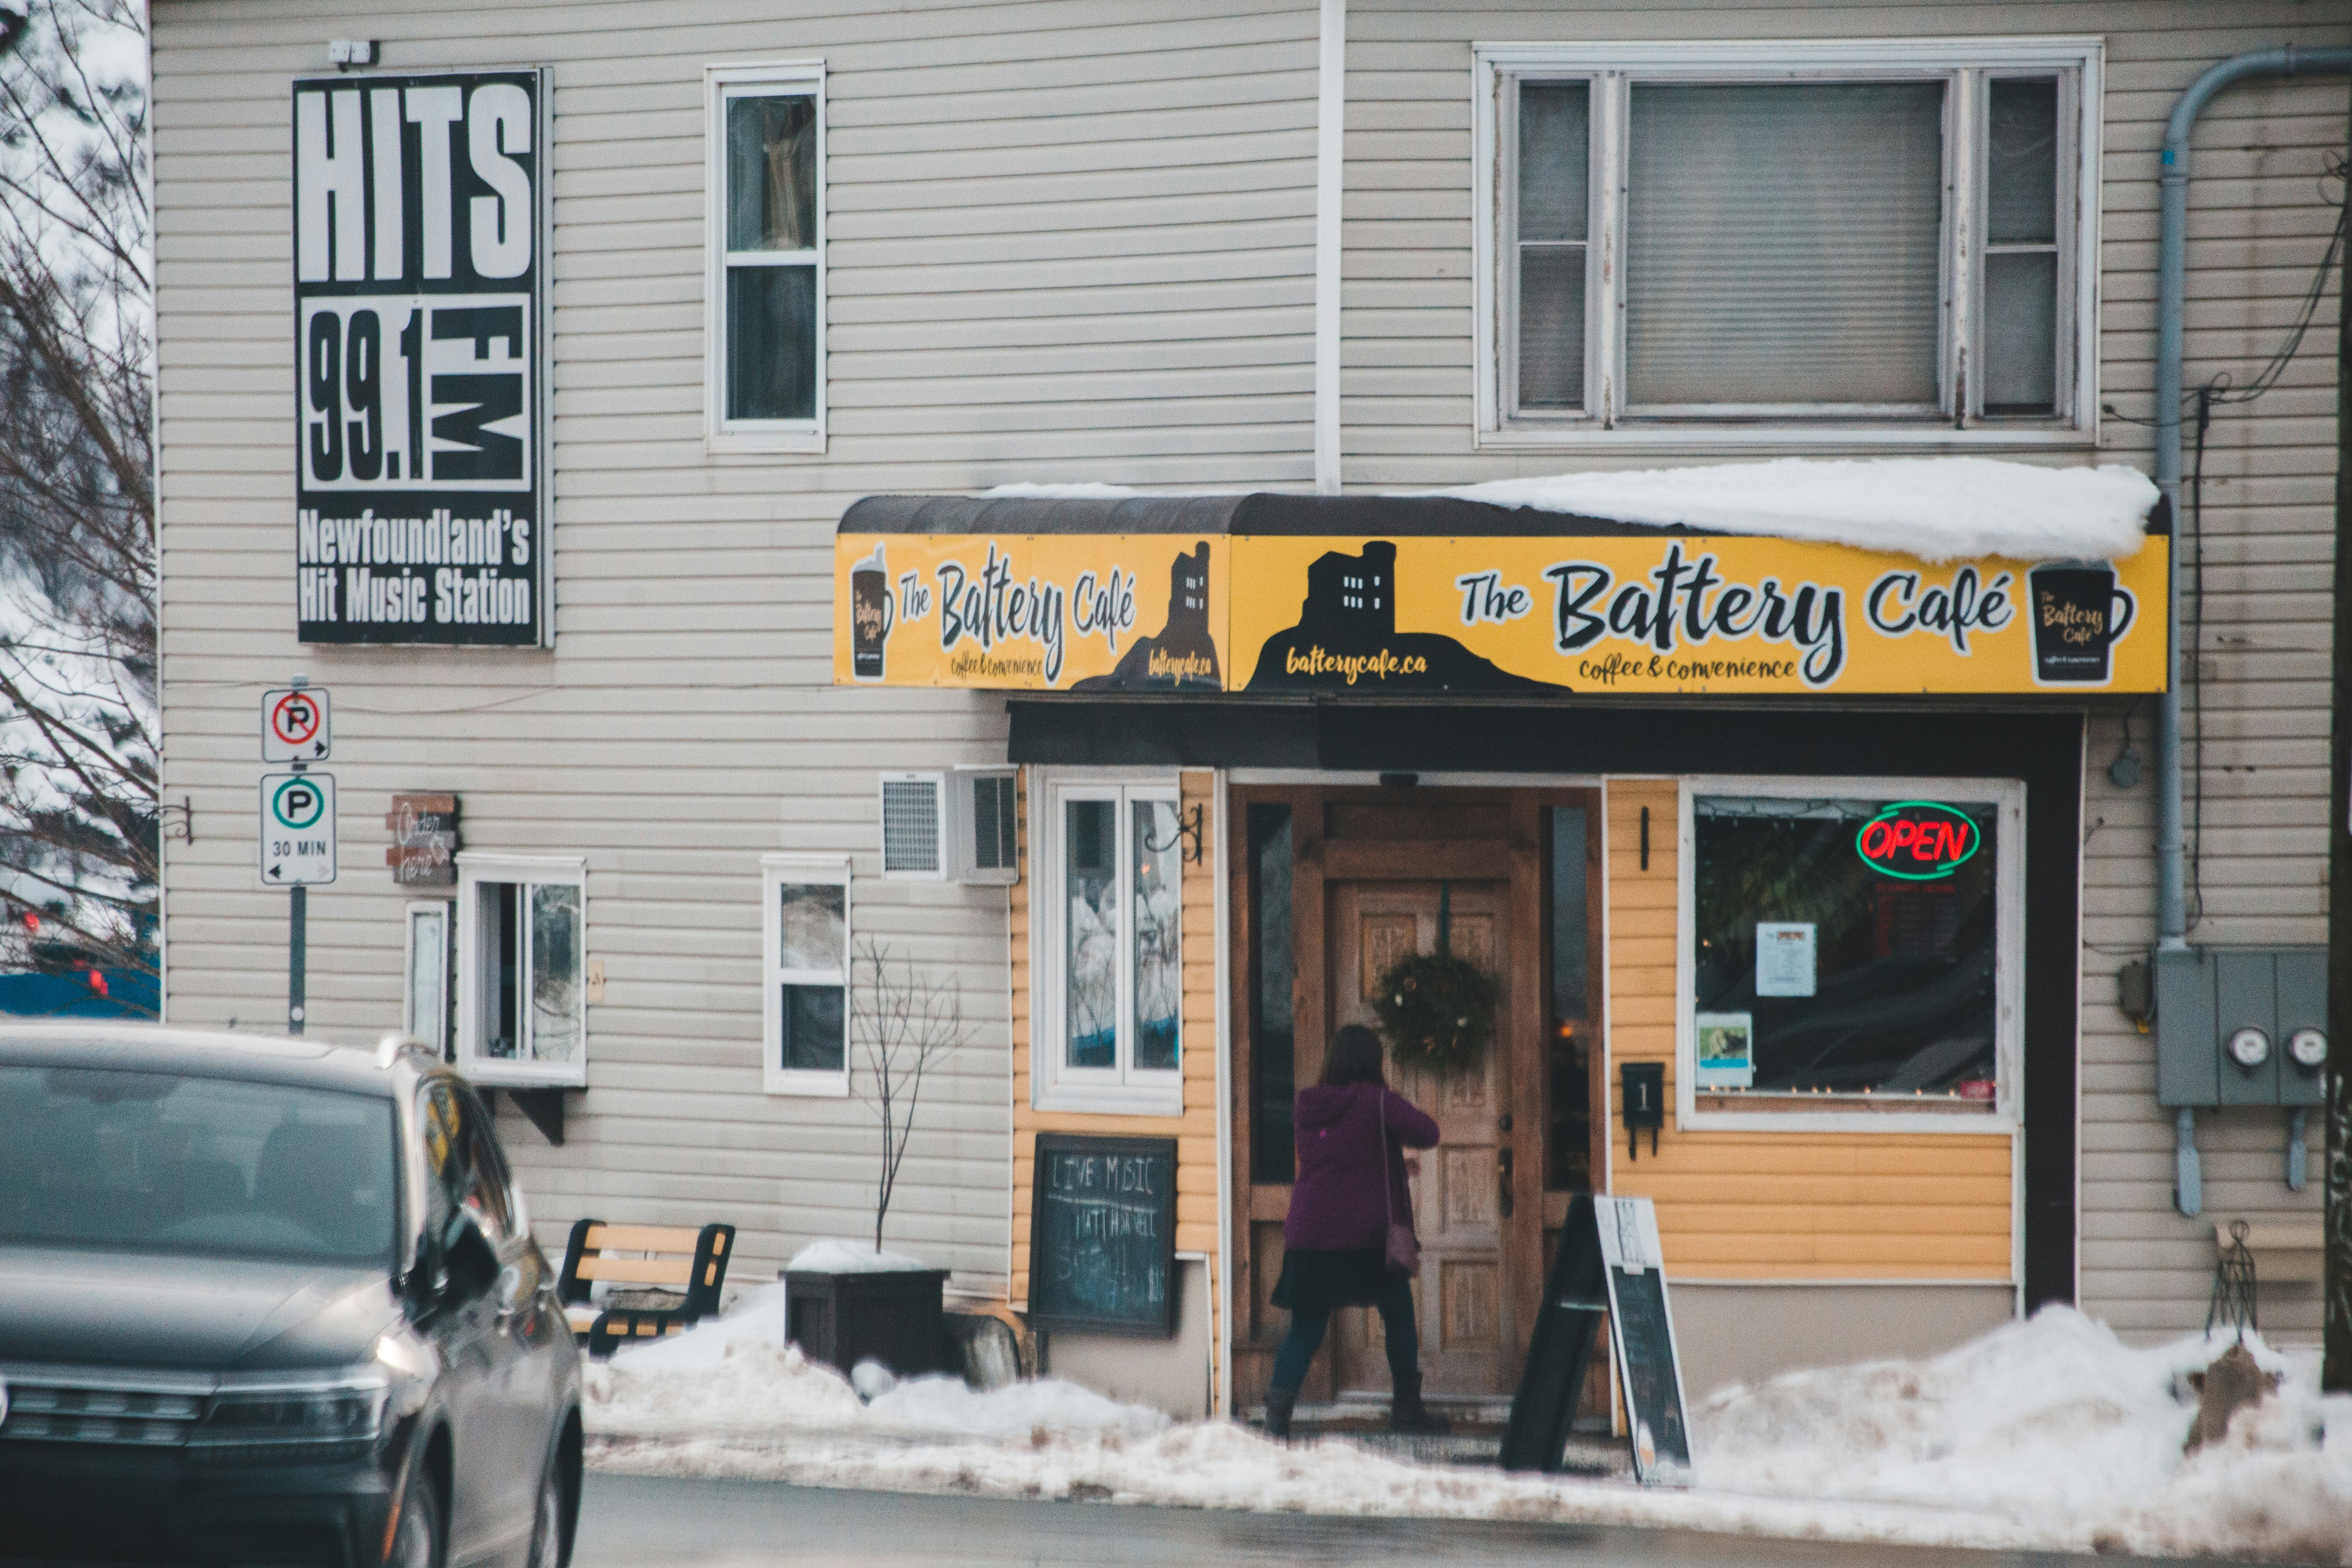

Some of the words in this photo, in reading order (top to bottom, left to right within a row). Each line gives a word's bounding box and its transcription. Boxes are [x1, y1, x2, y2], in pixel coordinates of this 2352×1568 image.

[297, 84, 531, 282] HITS
[309, 309, 423, 482] 99.1
[300, 508, 530, 565] Newfoundland's
[300, 567, 338, 622] Hit
[346, 567, 427, 623] Music
[435, 567, 530, 625] Station
[900, 574, 929, 619] The
[937, 545, 1063, 682] Battery
[1074, 569, 1135, 650] Café
[1461, 573, 1529, 621] The
[1546, 544, 1841, 684] Battery
[1868, 567, 2012, 651] Café
[2043, 600, 2103, 635] Battery
[1286, 645, 1427, 686] batterycafe.ca
[1579, 652, 1645, 686] coffee
[1666, 656, 1797, 680] convenience
[288, 791, 312, 818] P
[273, 841, 291, 857] 30
[298, 841, 326, 856] MIN
[1861, 819, 1969, 860] OPEN
[1052, 1155, 1094, 1191] LIVE
